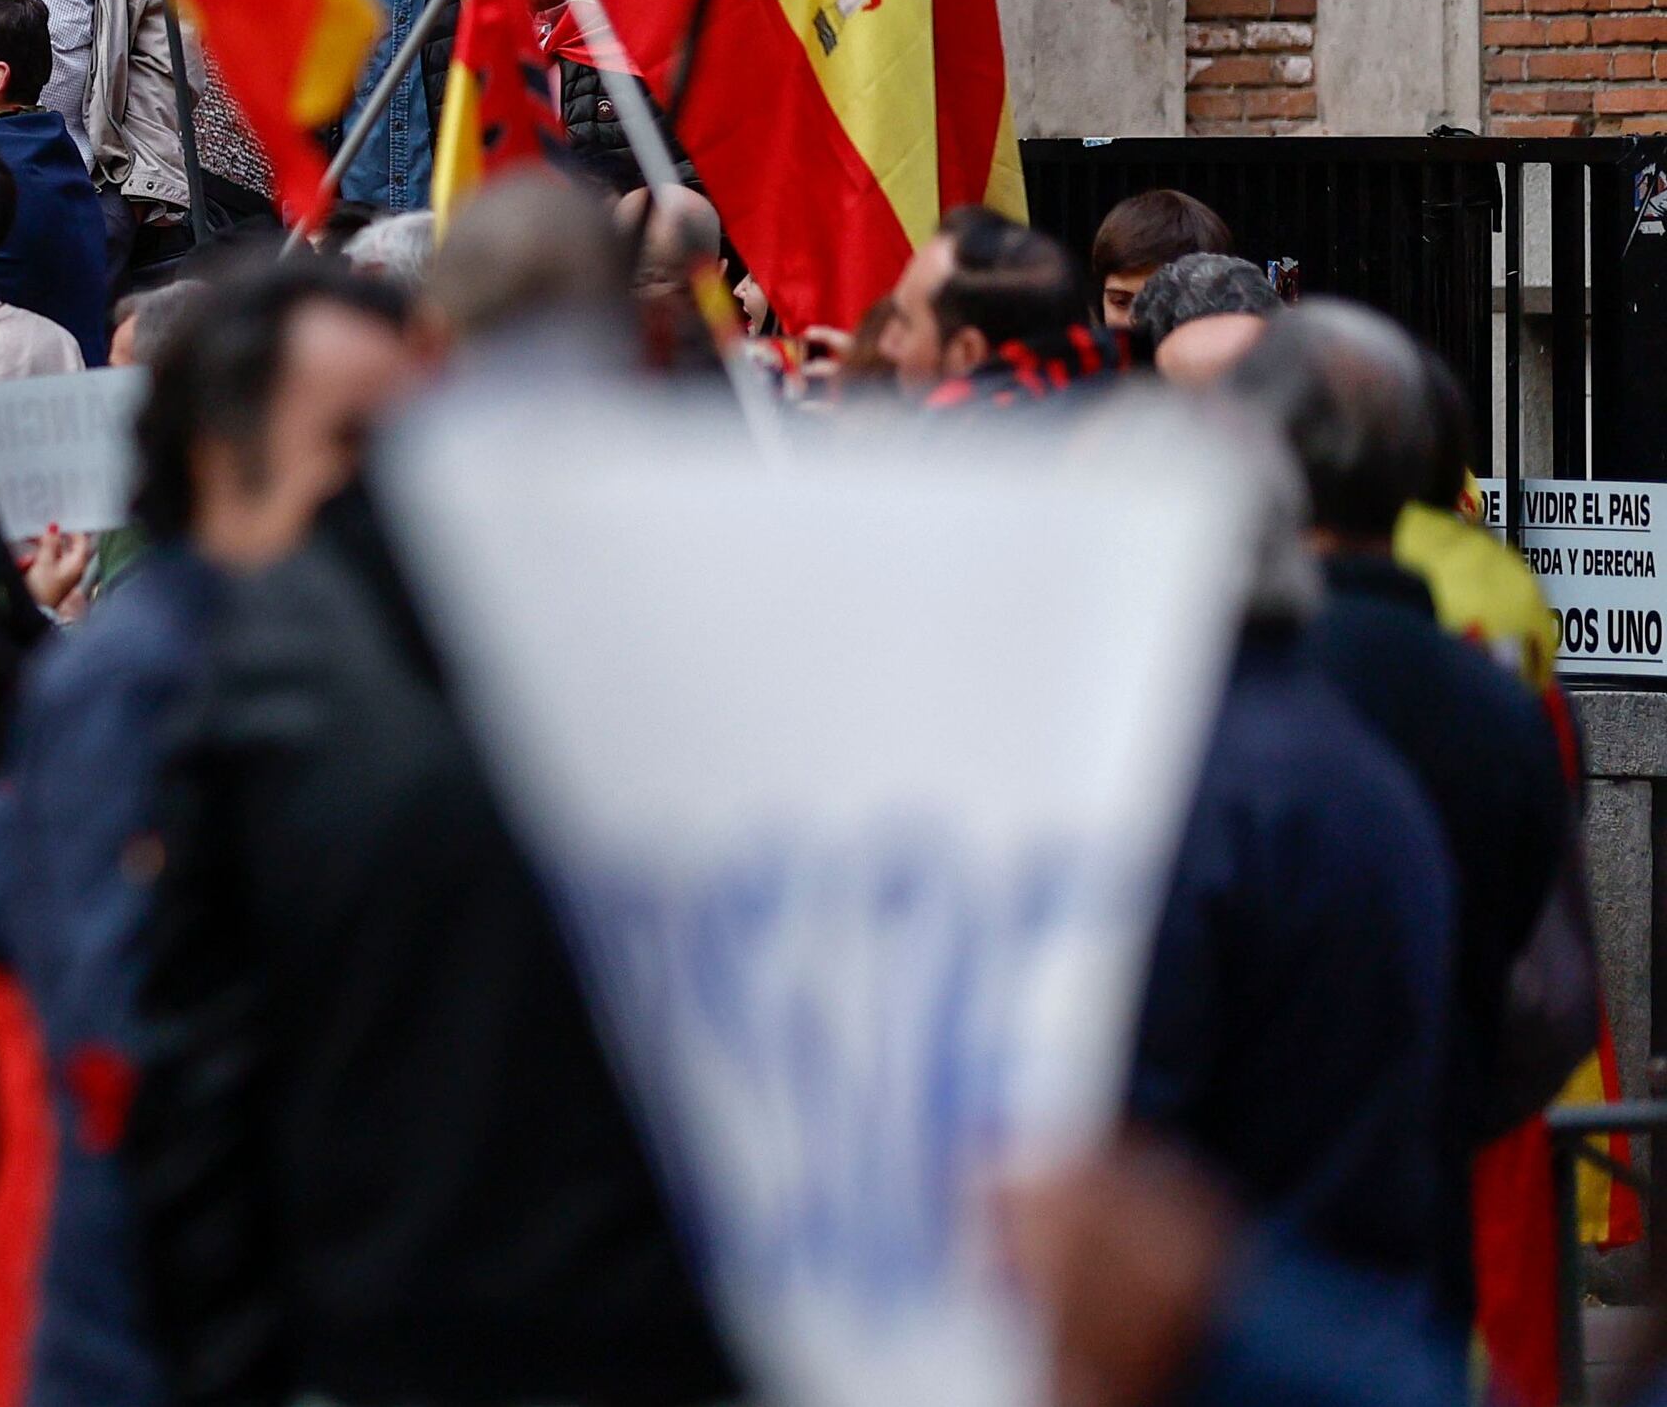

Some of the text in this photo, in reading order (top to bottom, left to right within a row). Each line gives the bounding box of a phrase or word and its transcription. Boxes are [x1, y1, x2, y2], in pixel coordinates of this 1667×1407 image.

[1480, 490, 1651, 527] DE VIDIR EL PAIS
[1522, 547, 1656, 578] ERDA Y DERECHA
[1547, 607, 1663, 655] DOS UNO
